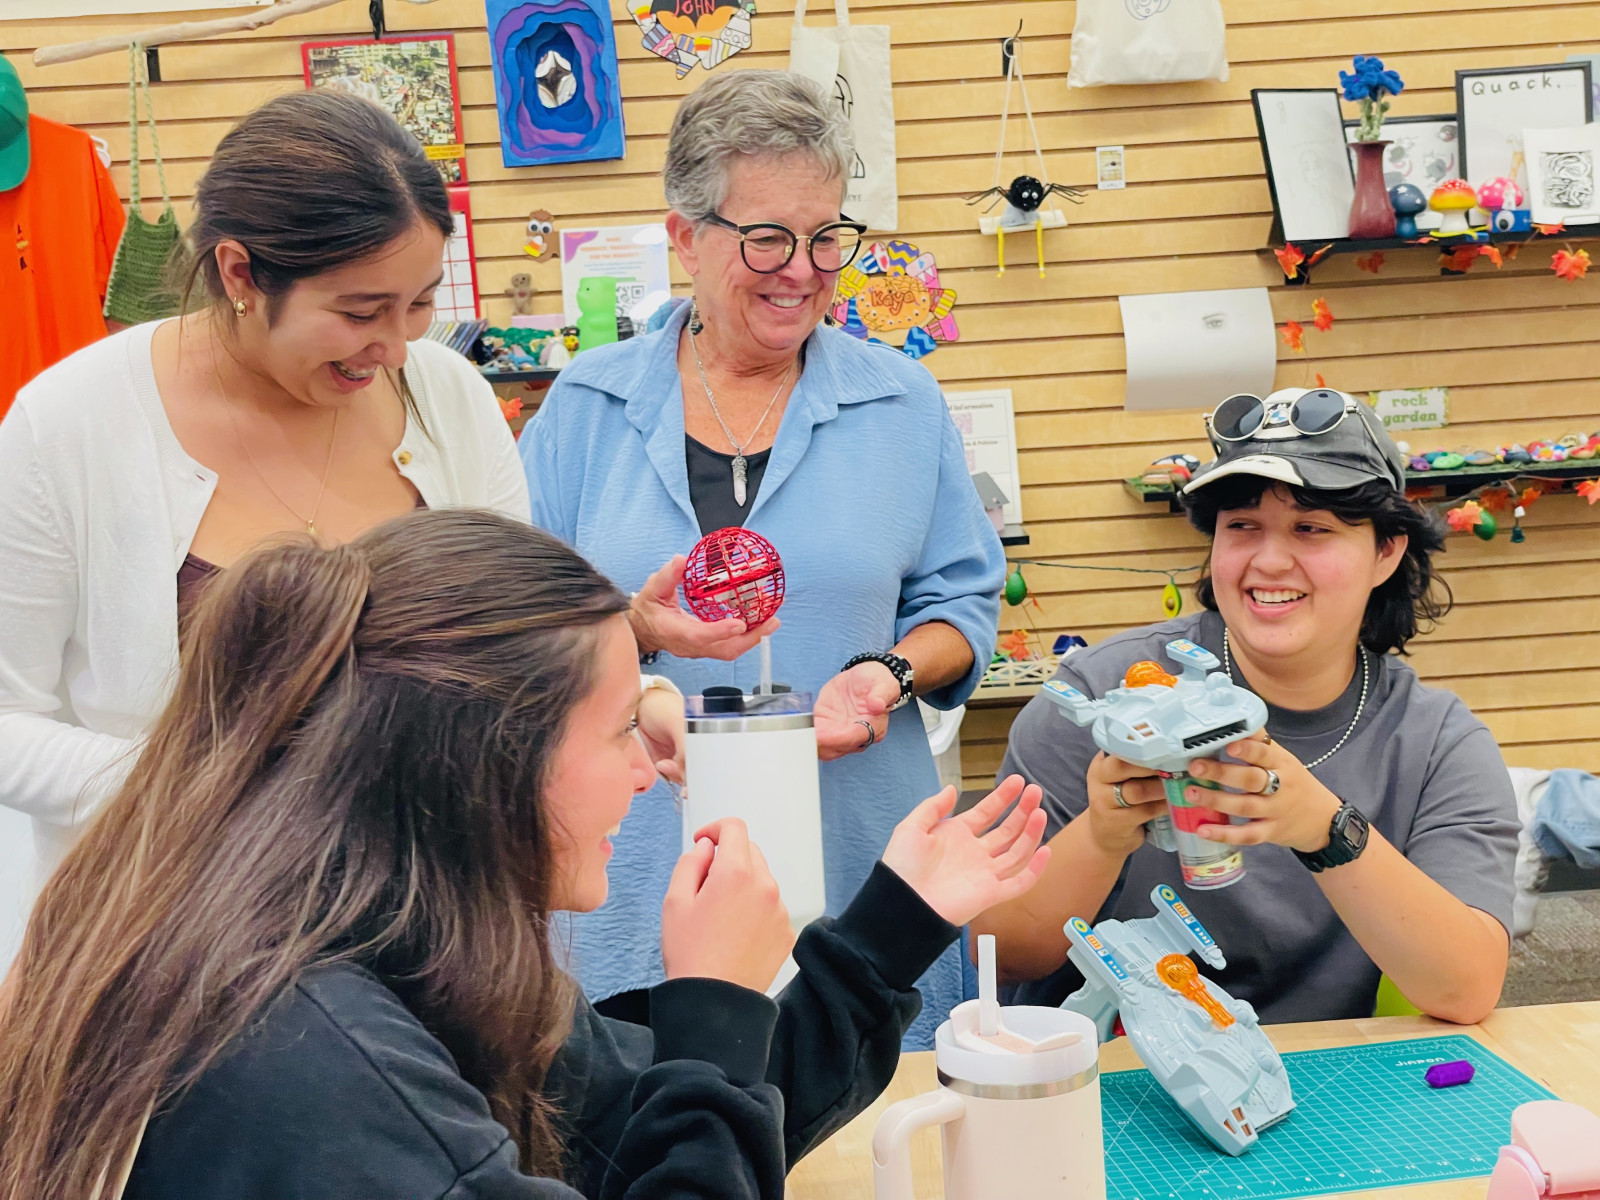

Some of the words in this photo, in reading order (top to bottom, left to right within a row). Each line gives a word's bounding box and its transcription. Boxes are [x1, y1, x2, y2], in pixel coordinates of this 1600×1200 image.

[1471, 72, 1561, 96] Quack.
[871, 290, 916, 316] Kaya
[1391, 394, 1428, 407] rock
[1383, 410, 1438, 427] garden
